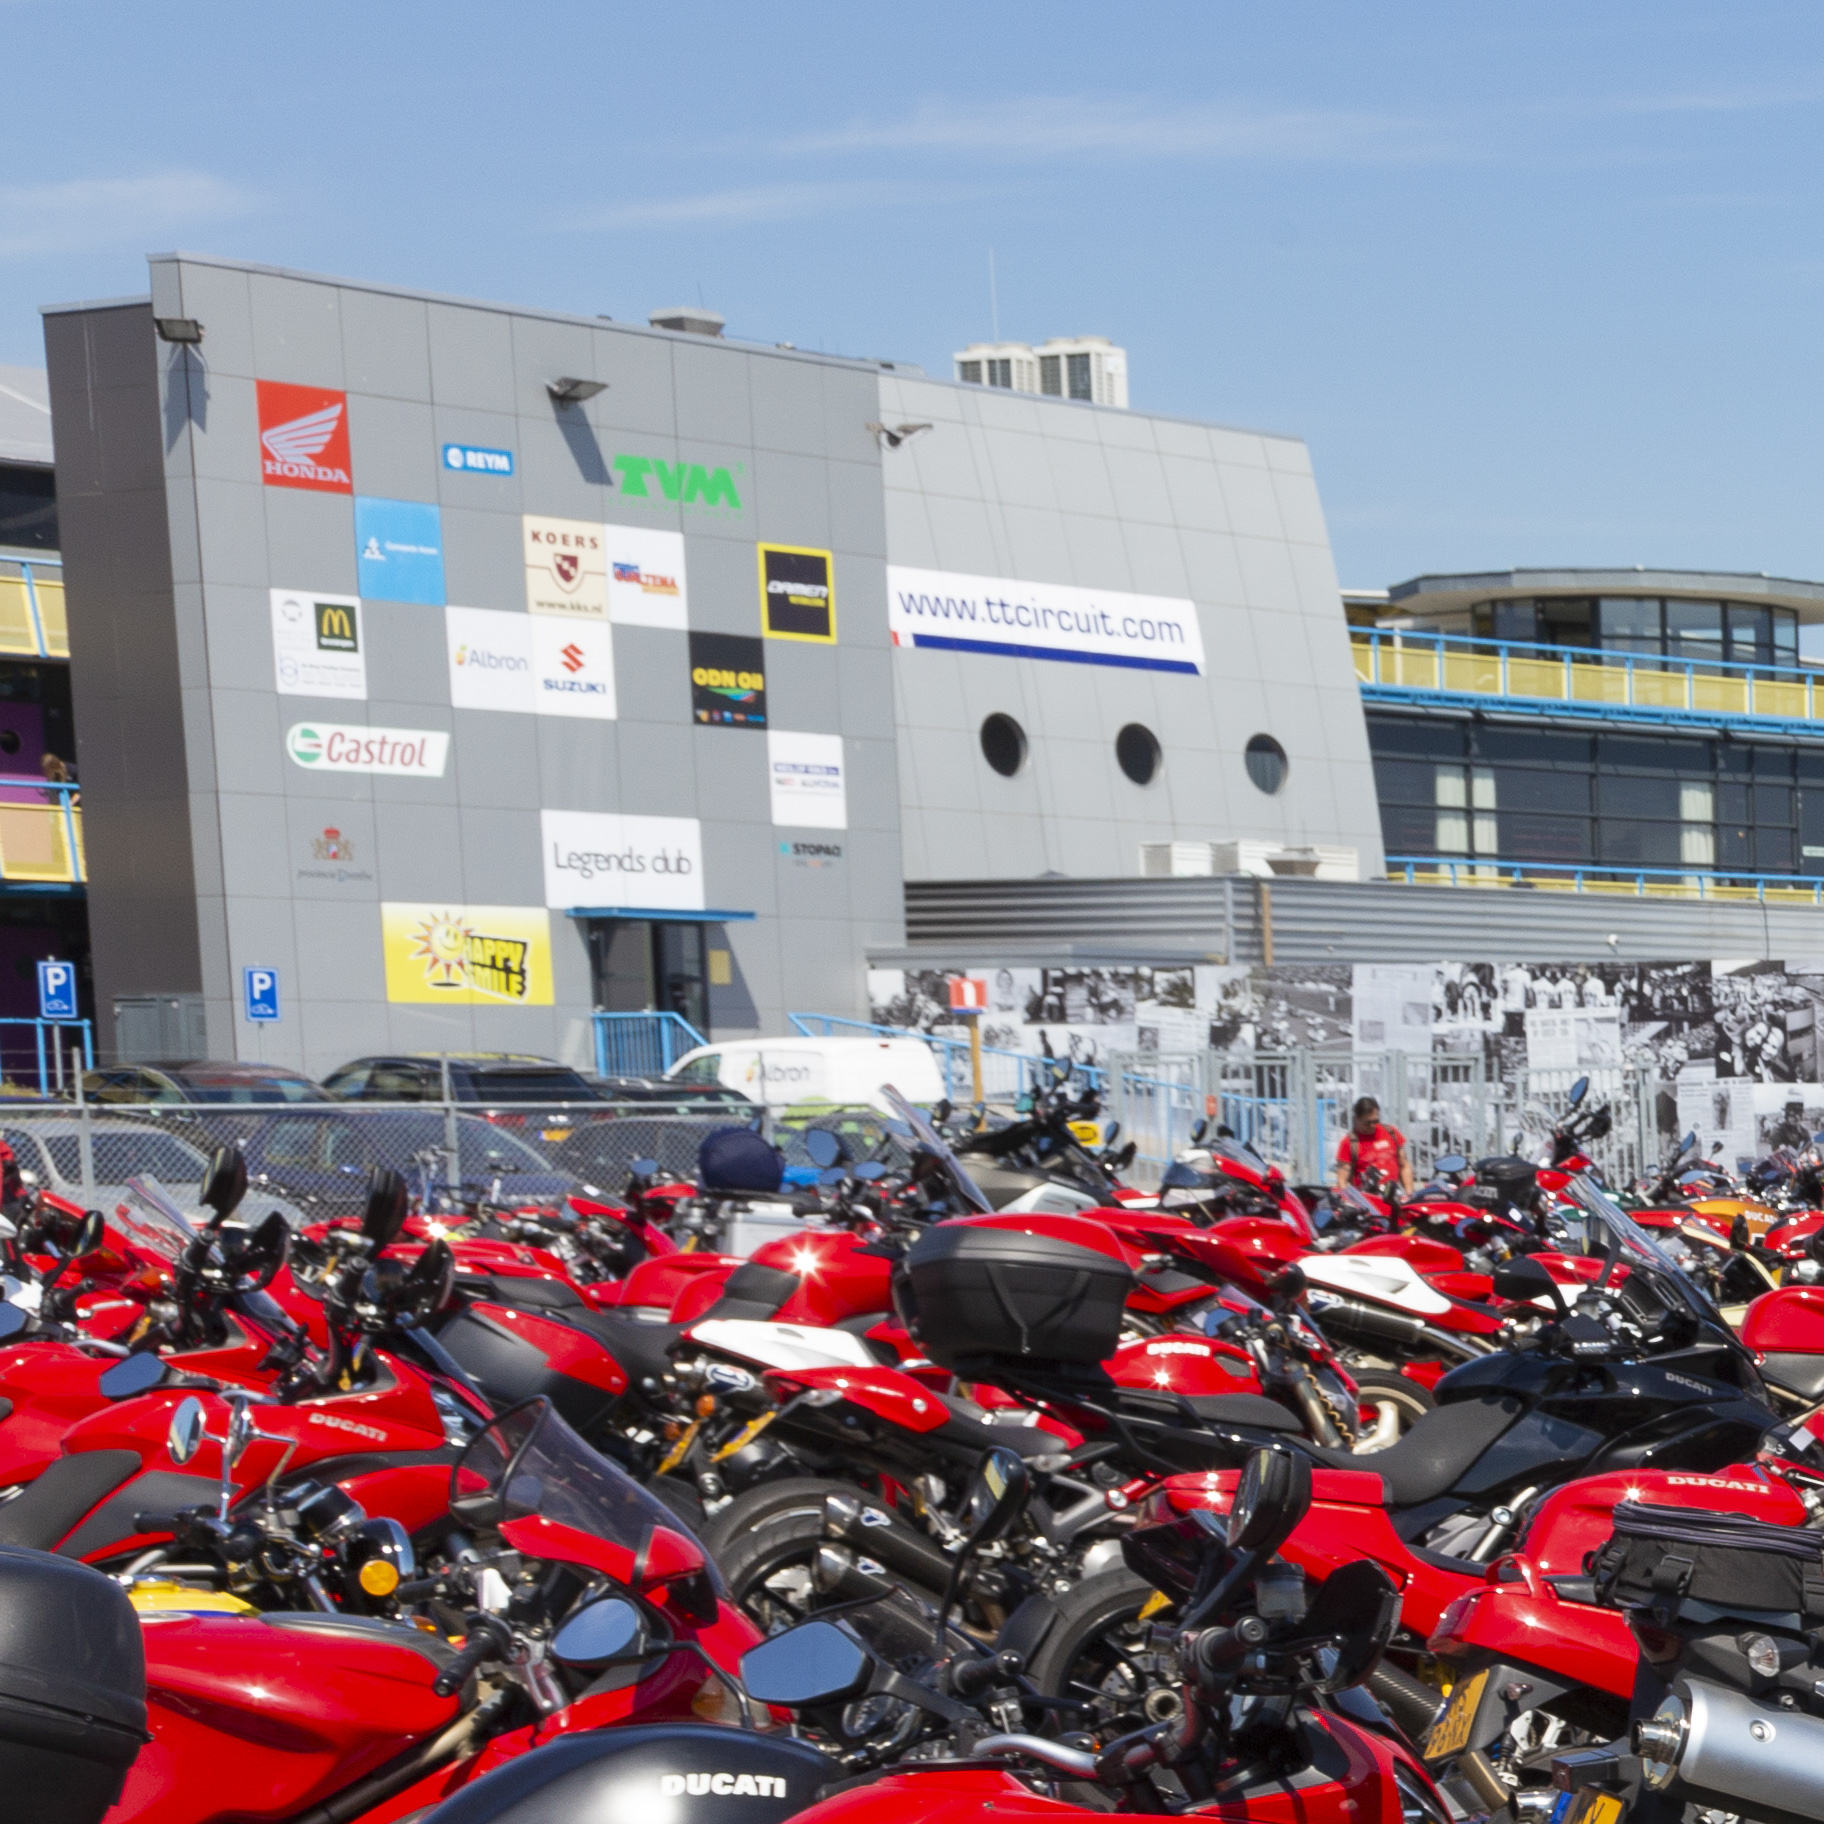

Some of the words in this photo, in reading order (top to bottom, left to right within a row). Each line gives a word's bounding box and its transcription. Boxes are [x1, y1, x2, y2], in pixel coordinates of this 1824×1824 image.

[263, 460, 351, 484] HONDA
[465, 451, 511, 471] REYM
[614, 453, 742, 510] TVM
[530, 529, 599, 552] KOERS
[899, 590, 1185, 645] www.ttcircuit.com
[468, 649, 528, 671] Albron
[543, 679, 607, 694] SUZUKI
[327, 731, 427, 767] Castrol
[554, 841, 645, 880] Legends
[465, 935, 523, 973] HAPPY
[465, 963, 523, 1000] SMILE
[1146, 1342, 1210, 1357] DUCATI
[1665, 1372, 1713, 1396] DUCATI
[309, 1411, 388, 1443] DUCATI
[1667, 1476, 1770, 1494] DUCATI
[661, 1772, 788, 1798] DUCATI
